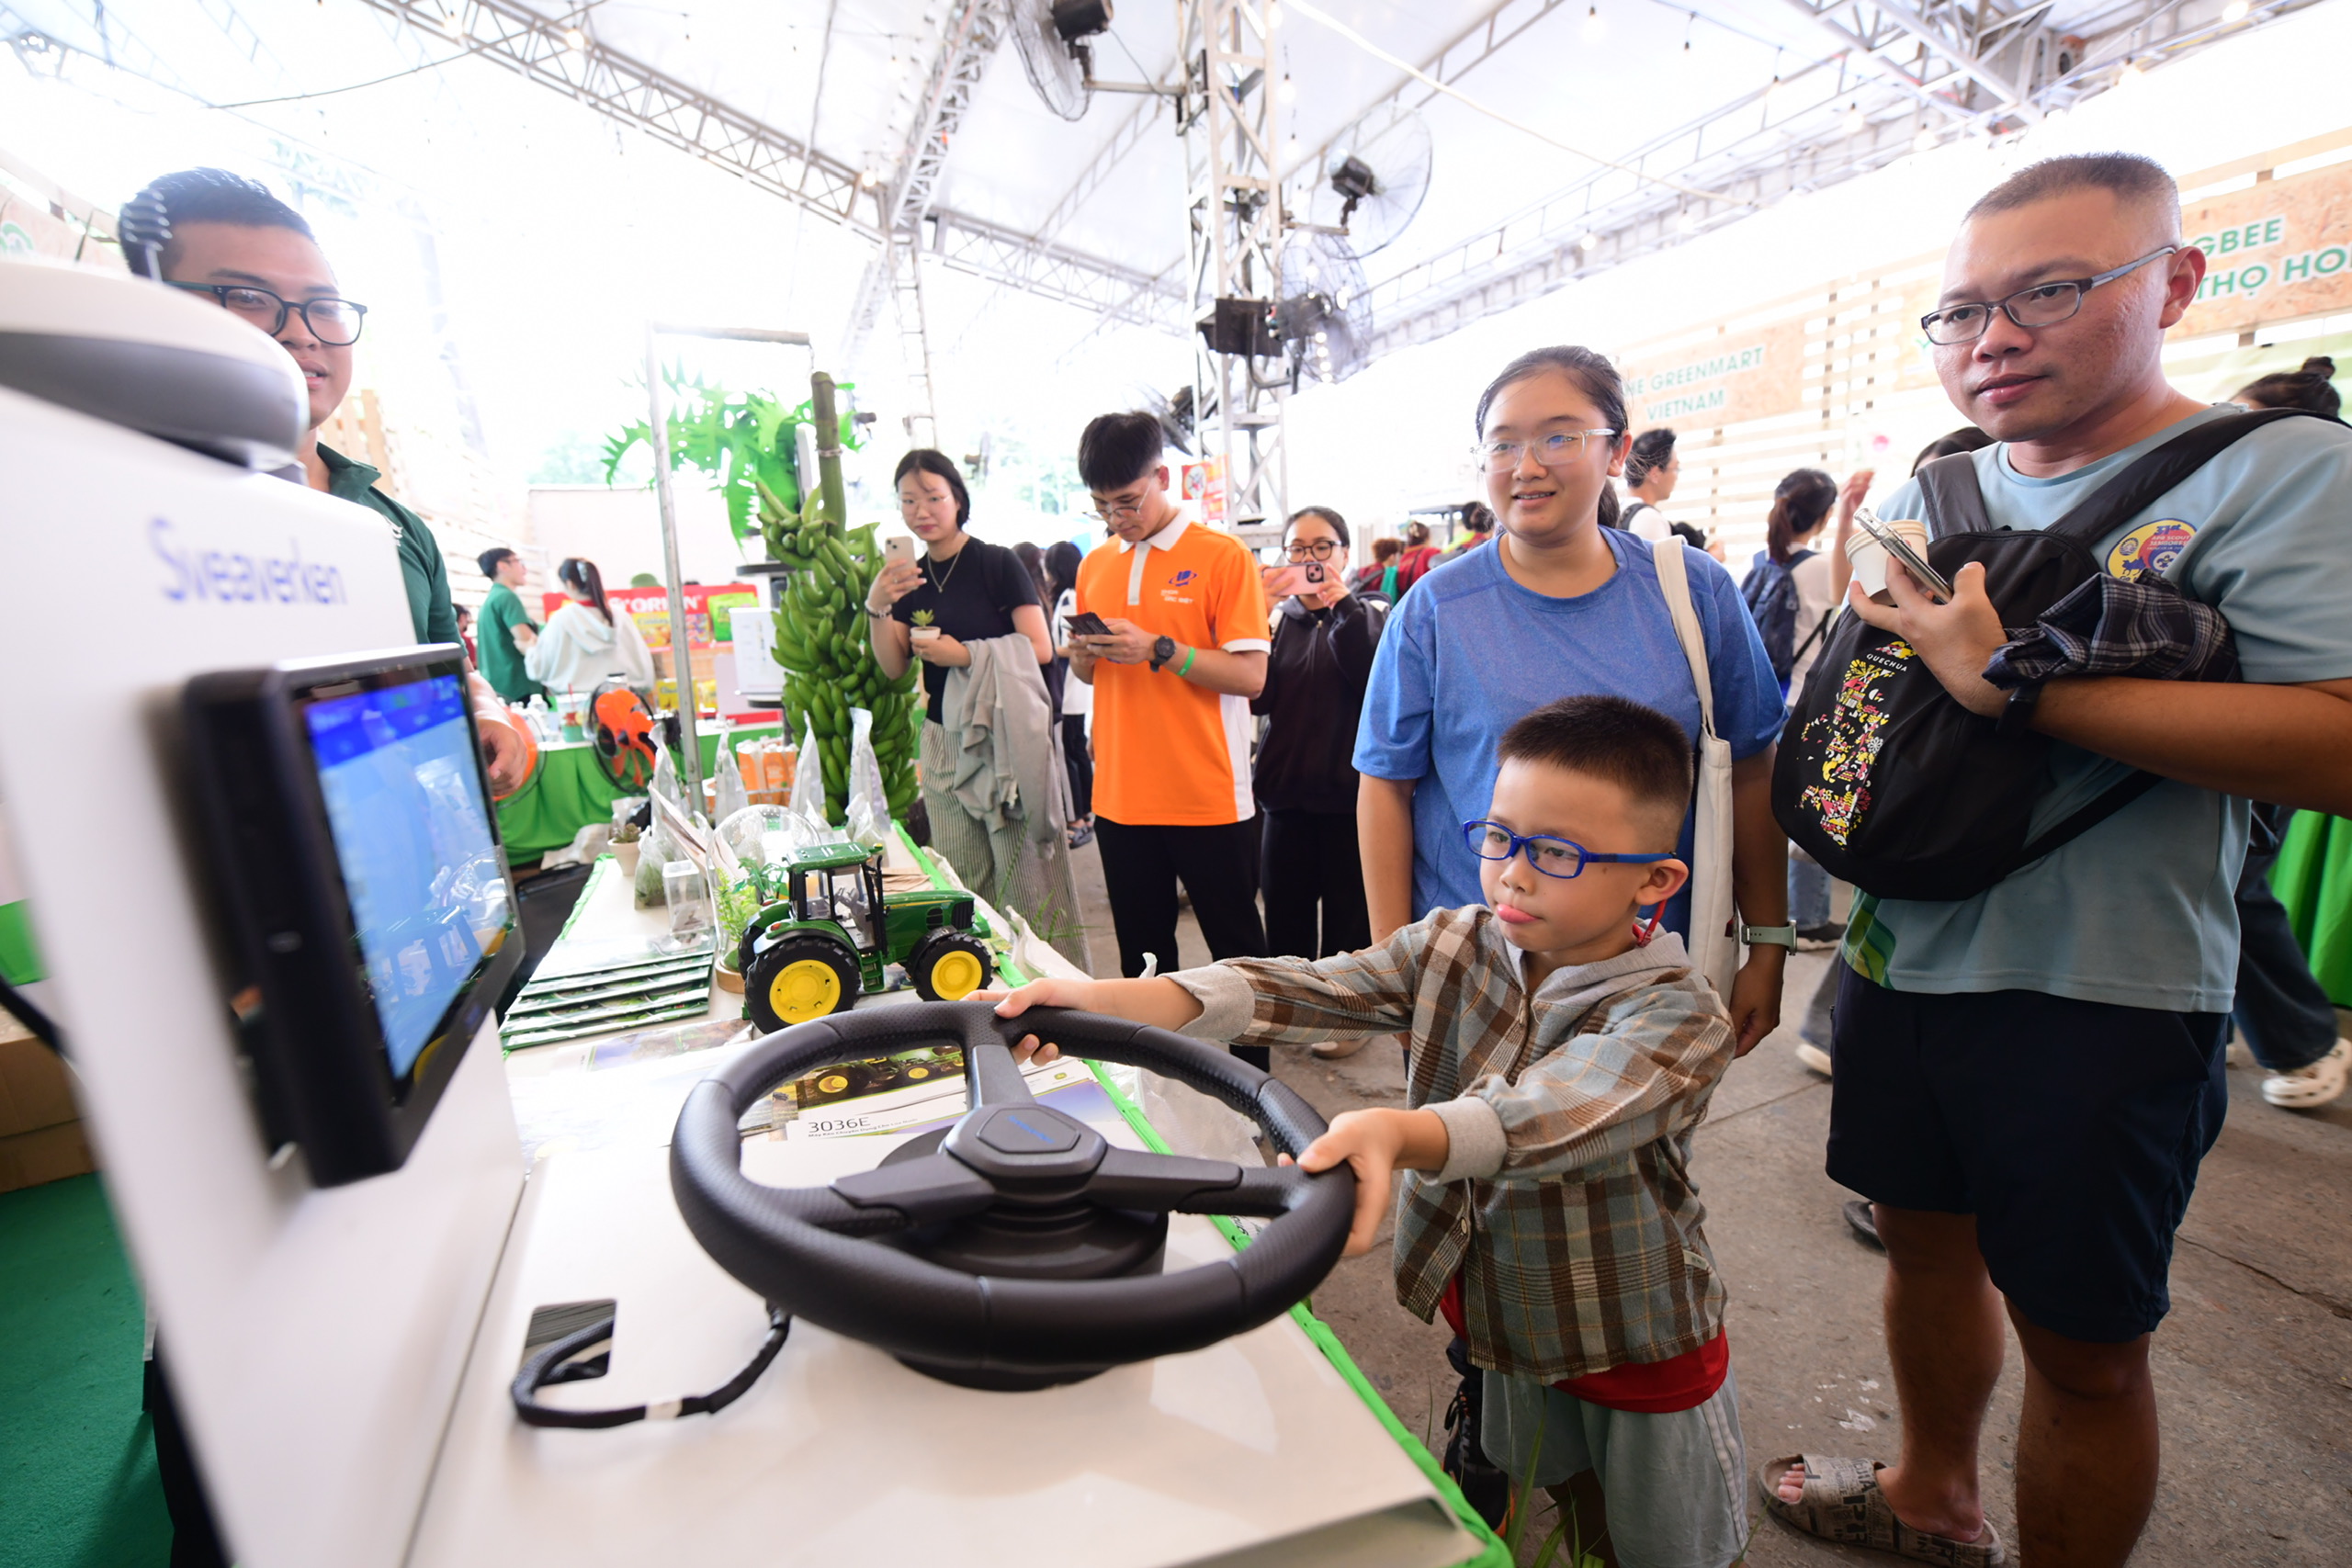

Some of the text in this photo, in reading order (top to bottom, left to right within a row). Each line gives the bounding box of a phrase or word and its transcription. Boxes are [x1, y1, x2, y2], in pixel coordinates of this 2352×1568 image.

[2182, 218, 2282, 257] GBEE
[2284, 248, 2352, 281] HO
[1623, 347, 1763, 397] HE GREENMART
[1647, 389, 1724, 421] VIETNAM
[631, 596, 698, 613] ORIN
[1866, 653, 1907, 672] QUECHUA
[808, 1117, 871, 1134] 3036E
